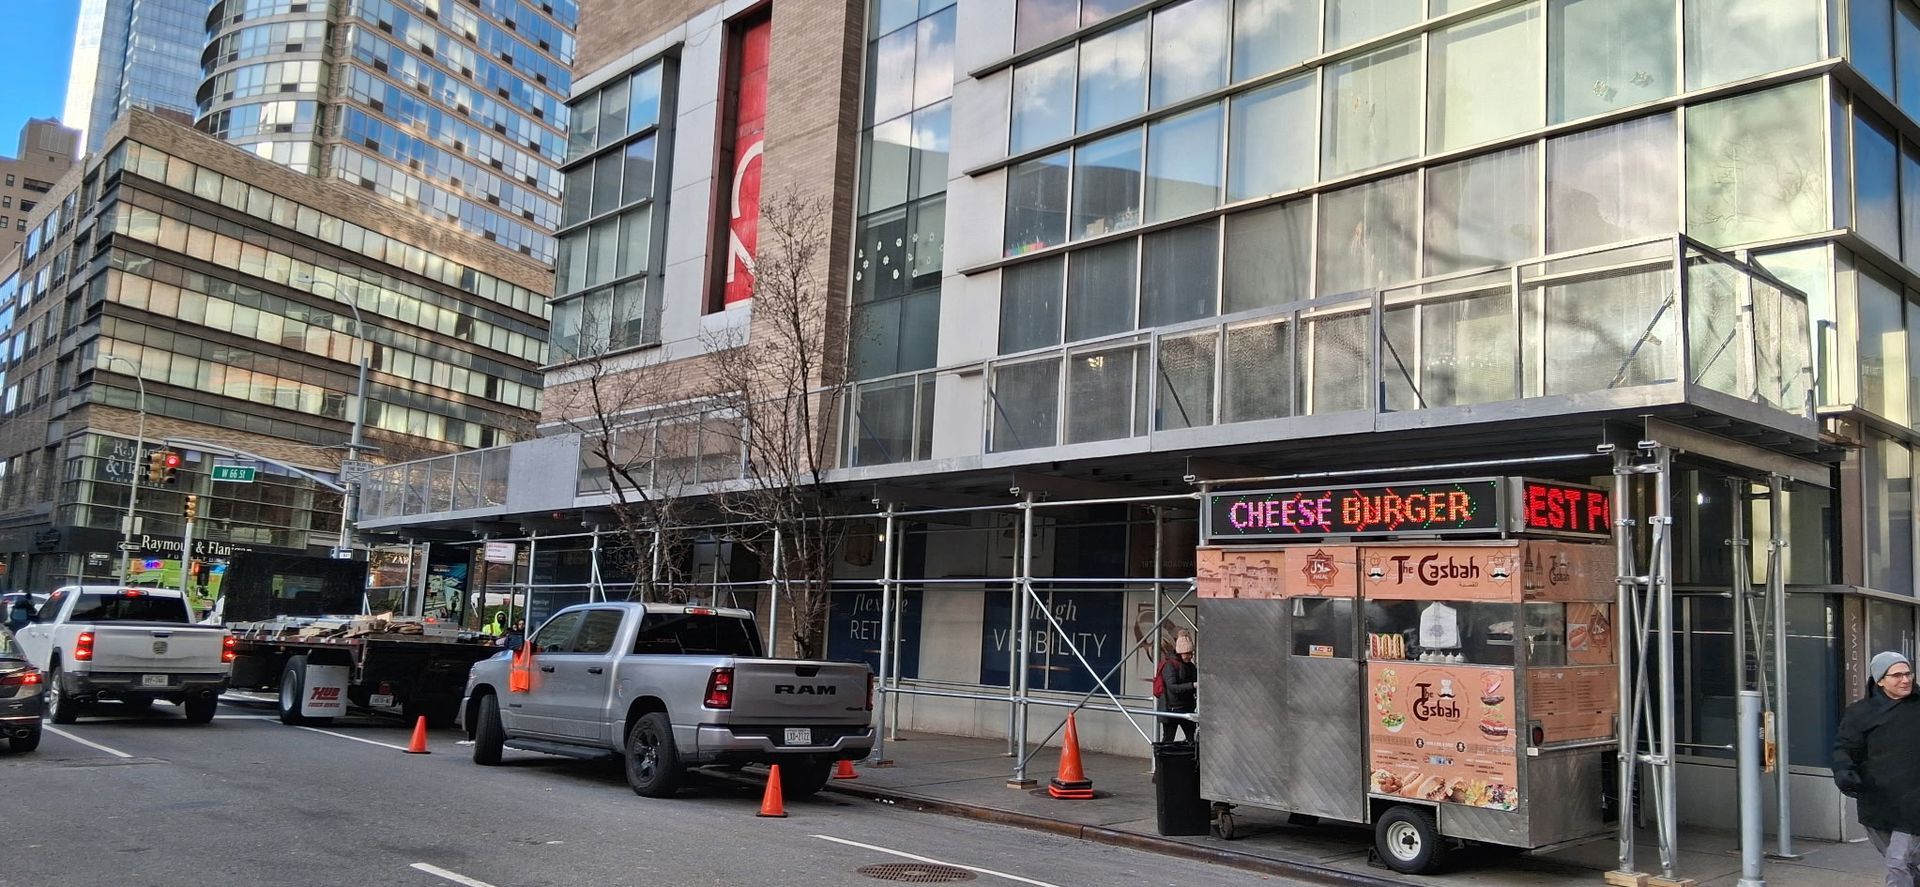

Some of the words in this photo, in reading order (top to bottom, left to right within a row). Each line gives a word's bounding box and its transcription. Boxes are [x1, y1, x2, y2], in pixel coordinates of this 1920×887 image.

[222, 468, 229, 478] W
[229, 468, 238, 479] 66
[238, 469, 246, 479] St
[1229, 497, 1331, 528] CHEESE
[1342, 491, 1471, 526] BURGER
[195, 541, 206, 555] &
[1390, 555, 1414, 584] The
[1418, 554, 1479, 586] Casbah
[310, 687, 341, 700] HUB
[775, 685, 836, 695] RAM
[1415, 683, 1434, 705] The
[1413, 697, 1460, 721] Casbah
